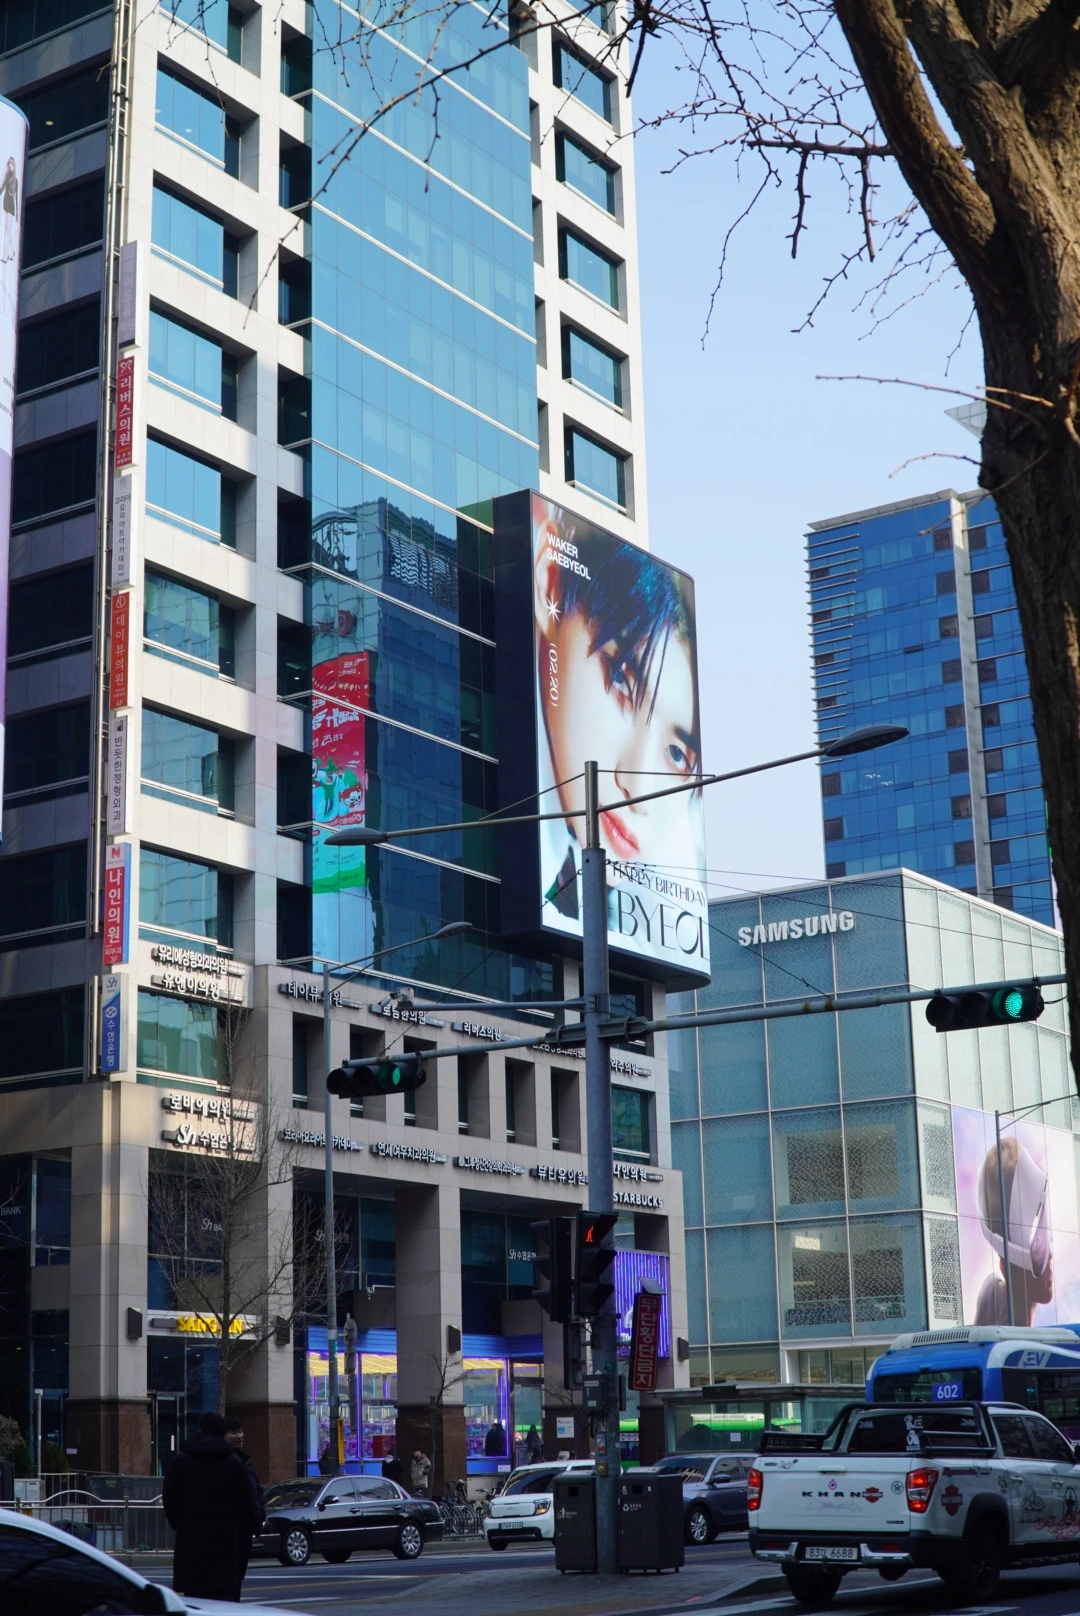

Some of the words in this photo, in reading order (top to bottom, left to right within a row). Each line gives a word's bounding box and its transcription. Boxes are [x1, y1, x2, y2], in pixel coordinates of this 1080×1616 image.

[119, 375, 132, 446] 리버스의원
[547, 532, 579, 560] WAKER
[546, 547, 591, 581] SAEBYEOL
[114, 613, 125, 686] 데이뷰의원
[113, 736, 123, 821] 반듯한정형외과
[655, 876, 706, 907] BIRTHDAY
[107, 868, 122, 944] 나인의원
[738, 911, 854, 947] SAMSUNG
[158, 945, 228, 975] 유리에성형외과의원
[106, 977, 117, 989] Sh
[163, 972, 220, 1000] 유앤미의원
[106, 1019, 115, 1067] 수협은행
[463, 1021, 501, 1041] 리버스의원
[170, 1094, 231, 1120] 로바에의원
[177, 1124, 197, 1145] Sh
[377, 1142, 436, 1163] 연세여우치과의원
[537, 1165, 586, 1186] 뷰티유의원
[0, 1205, 22, 1216] BANK
[613, 1191, 663, 1208] STARBUCKS
[636, 1297, 658, 1388] 무단횡단금지
[1023, 1351, 1046, 1368] EV
[936, 1384, 959, 1399] 602
[830, 1548, 854, 1559] 6688
